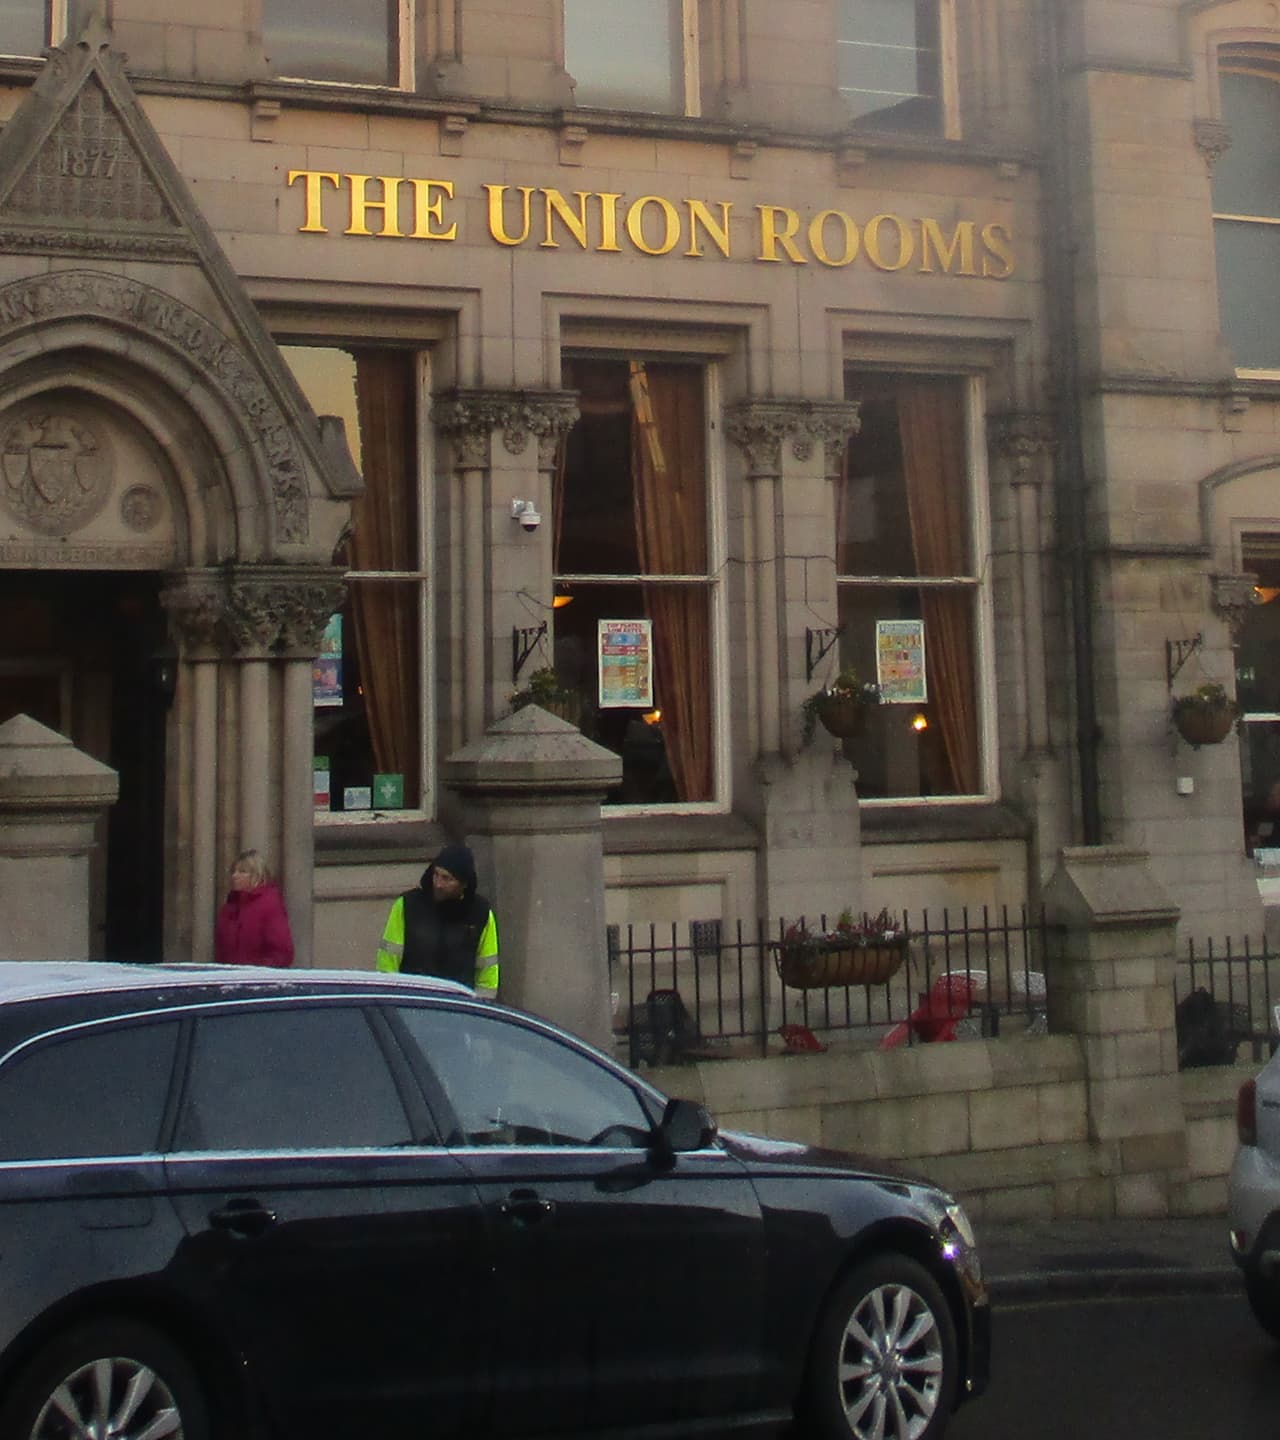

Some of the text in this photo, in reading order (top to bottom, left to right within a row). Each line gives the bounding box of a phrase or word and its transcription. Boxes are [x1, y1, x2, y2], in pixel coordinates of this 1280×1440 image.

[60, 145, 117, 179] 1877
[287, 169, 1017, 280] THE UNION ROOMS
